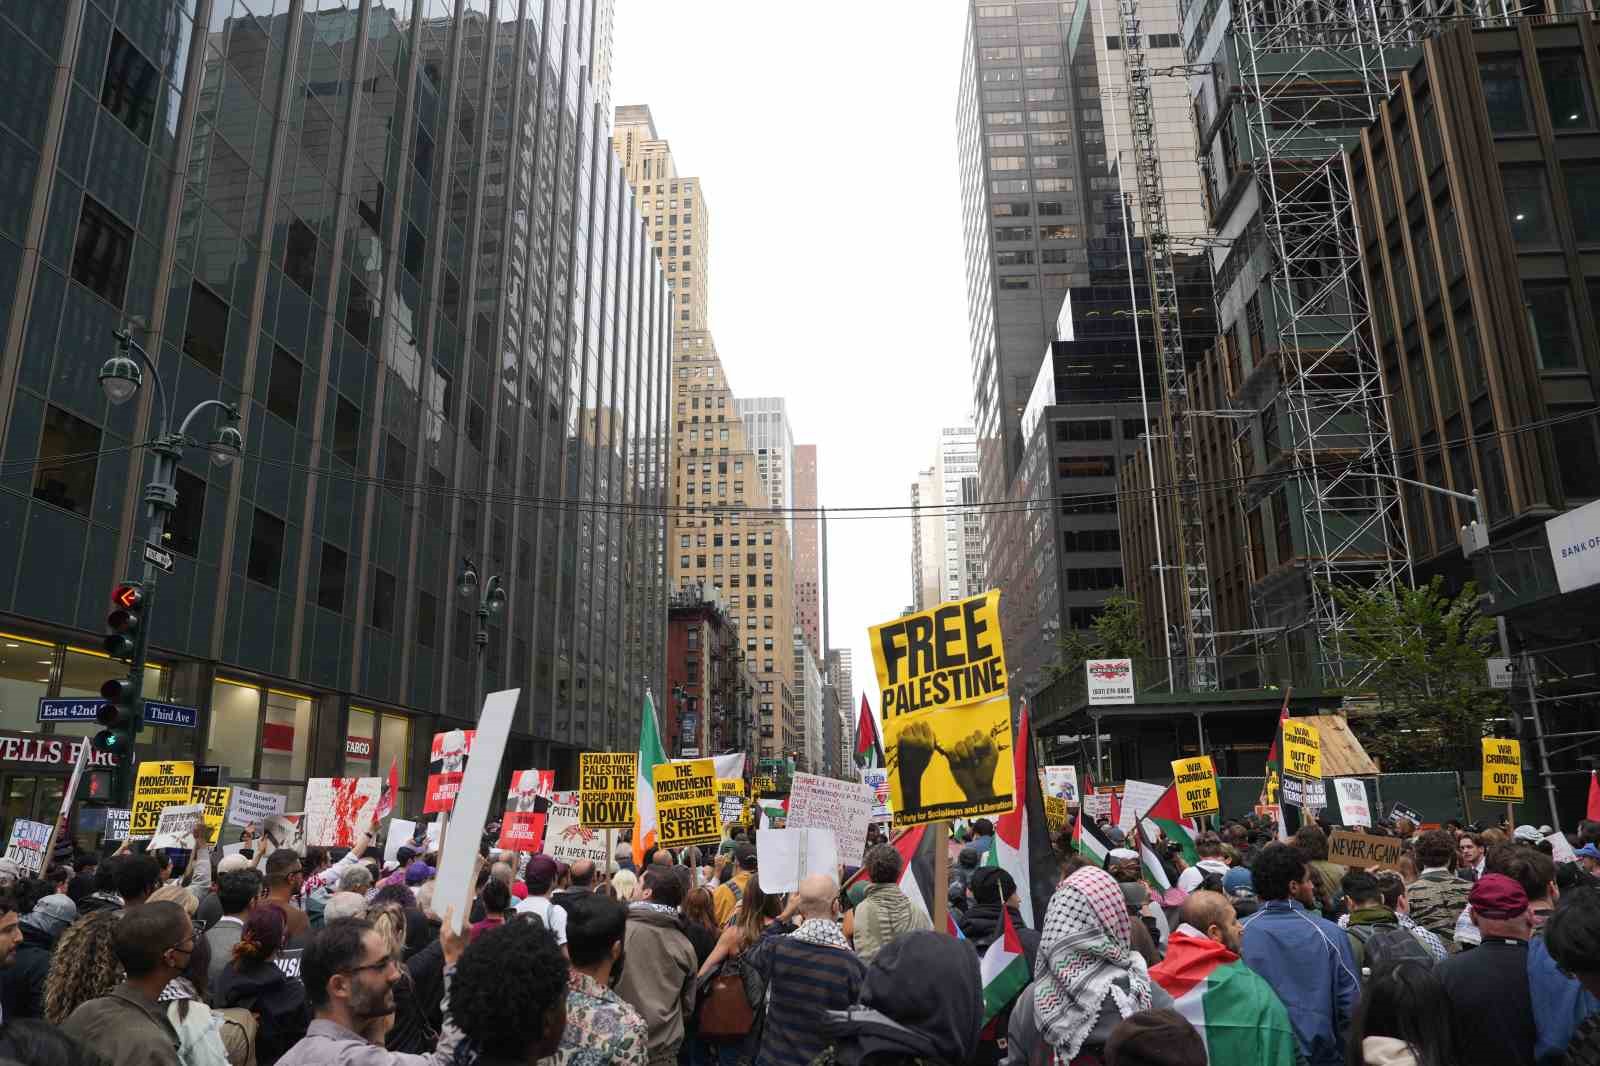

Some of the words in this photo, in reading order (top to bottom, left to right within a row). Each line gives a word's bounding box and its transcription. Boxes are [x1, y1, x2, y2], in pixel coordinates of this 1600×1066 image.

[1561, 542, 1588, 558] BANK
[880, 597, 993, 685] FREE
[882, 656, 1006, 720] PALESTINE
[43, 704, 68, 717] East
[70, 704, 97, 717] 42nd
[151, 706, 174, 721] Third
[174, 709, 190, 723] Ave
[1294, 726, 1309, 738] WAR
[346, 740, 370, 755] FARGO
[1497, 744, 1512, 754] WAR
[582, 754, 611, 764] STAND
[613, 754, 635, 764] WITH
[1290, 750, 1305, 762] OUT
[1307, 754, 1316, 765] OF
[160, 764, 175, 775] THE
[583, 765, 635, 775] PALESTINE!
[675, 764, 693, 777] THE
[1187, 762, 1201, 772] WAR
[139, 775, 191, 787] MOVEMENT
[583, 776, 609, 790] END
[612, 776, 635, 790] THE
[1177, 770, 1212, 784] CRIMINALS
[1493, 773, 1509, 784] OUT
[1510, 774, 1518, 784] OF
[656, 775, 713, 794] MOVEMENT
[721, 782, 736, 790] WAR
[1284, 780, 1313, 793] ZIONIM
[191, 788, 227, 806] FREE
[582, 792, 635, 802] OCCUPATION
[657, 791, 695, 802] CONTINUES
[695, 787, 714, 799] UNTIL
[1186, 789, 1202, 800] OUT
[1203, 787, 1211, 798] OF
[582, 802, 634, 823] NOW!
[658, 803, 716, 823] PALESTINE
[963, 805, 978, 814] and
[134, 812, 147, 827] IS
[660, 821, 675, 840] IS
[678, 816, 718, 838] FREE!
[554, 846, 565, 856] IN
[1332, 838, 1364, 859] NEVER
[1367, 844, 1399, 865] AGAIN
